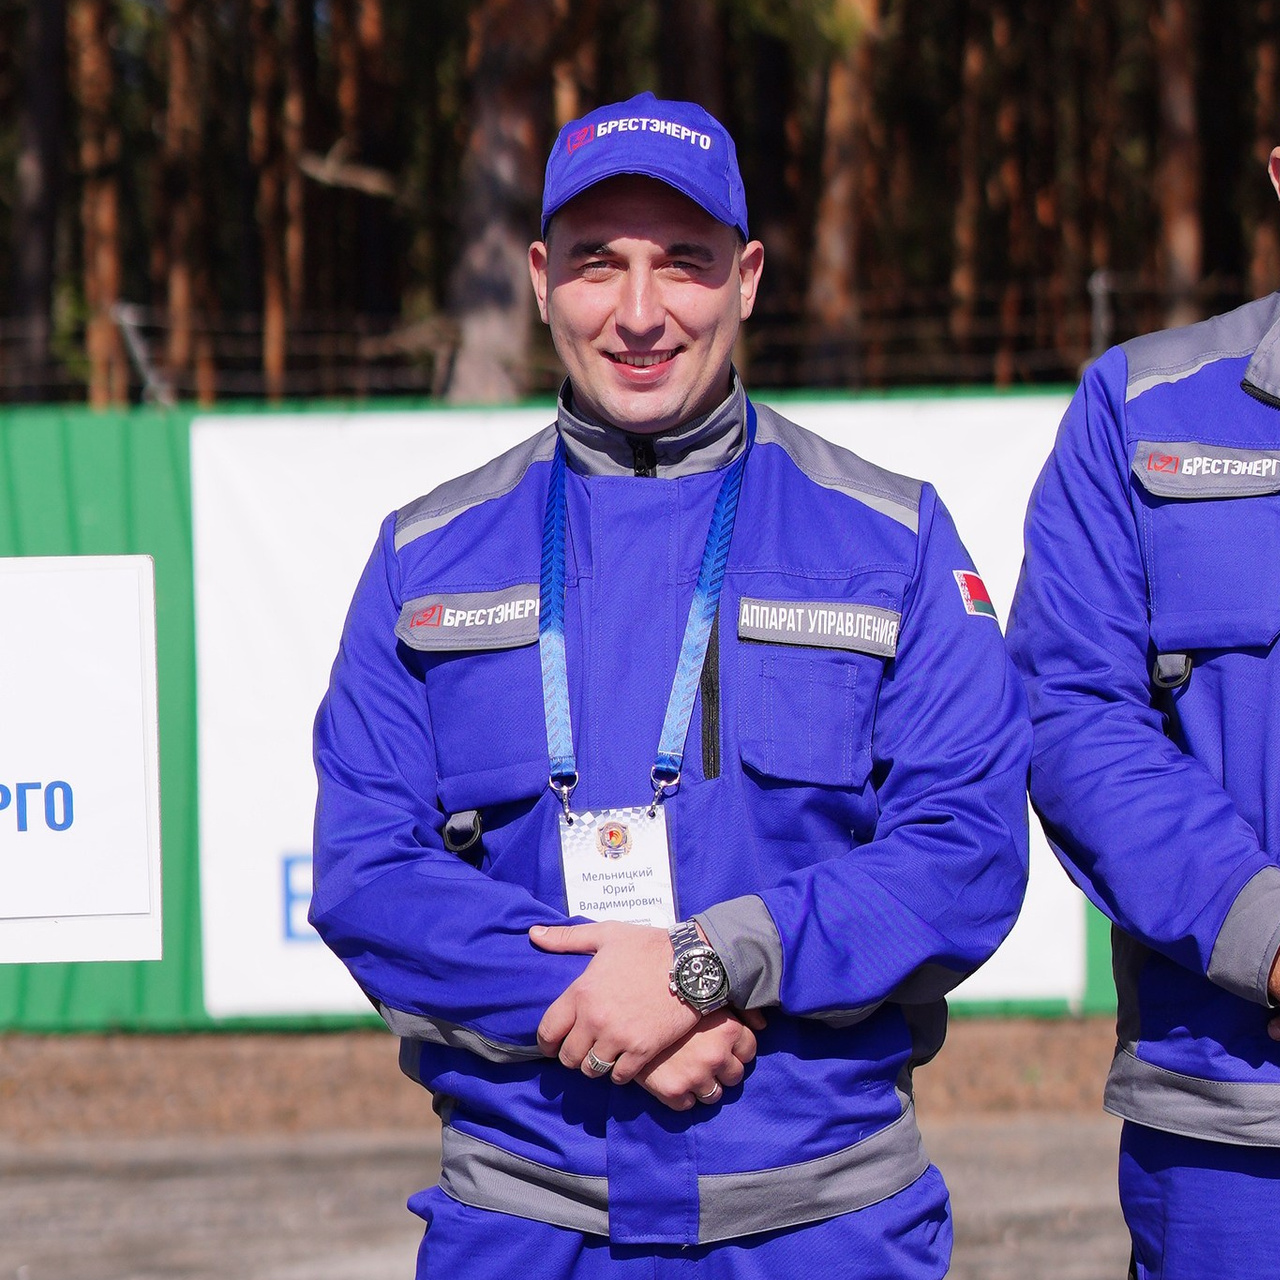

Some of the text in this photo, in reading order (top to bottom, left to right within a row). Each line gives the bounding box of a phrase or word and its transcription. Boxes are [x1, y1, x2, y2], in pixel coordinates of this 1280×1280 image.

[597, 118, 711, 150] БРЕСТЭНЕРГО
[740, 604, 898, 646] АППАРАТ УПРАВЛЕНИЯ
[582, 867, 653, 882] Мельницкий
[603, 883, 635, 896] Юрий
[579, 897, 662, 911] Владимирович
